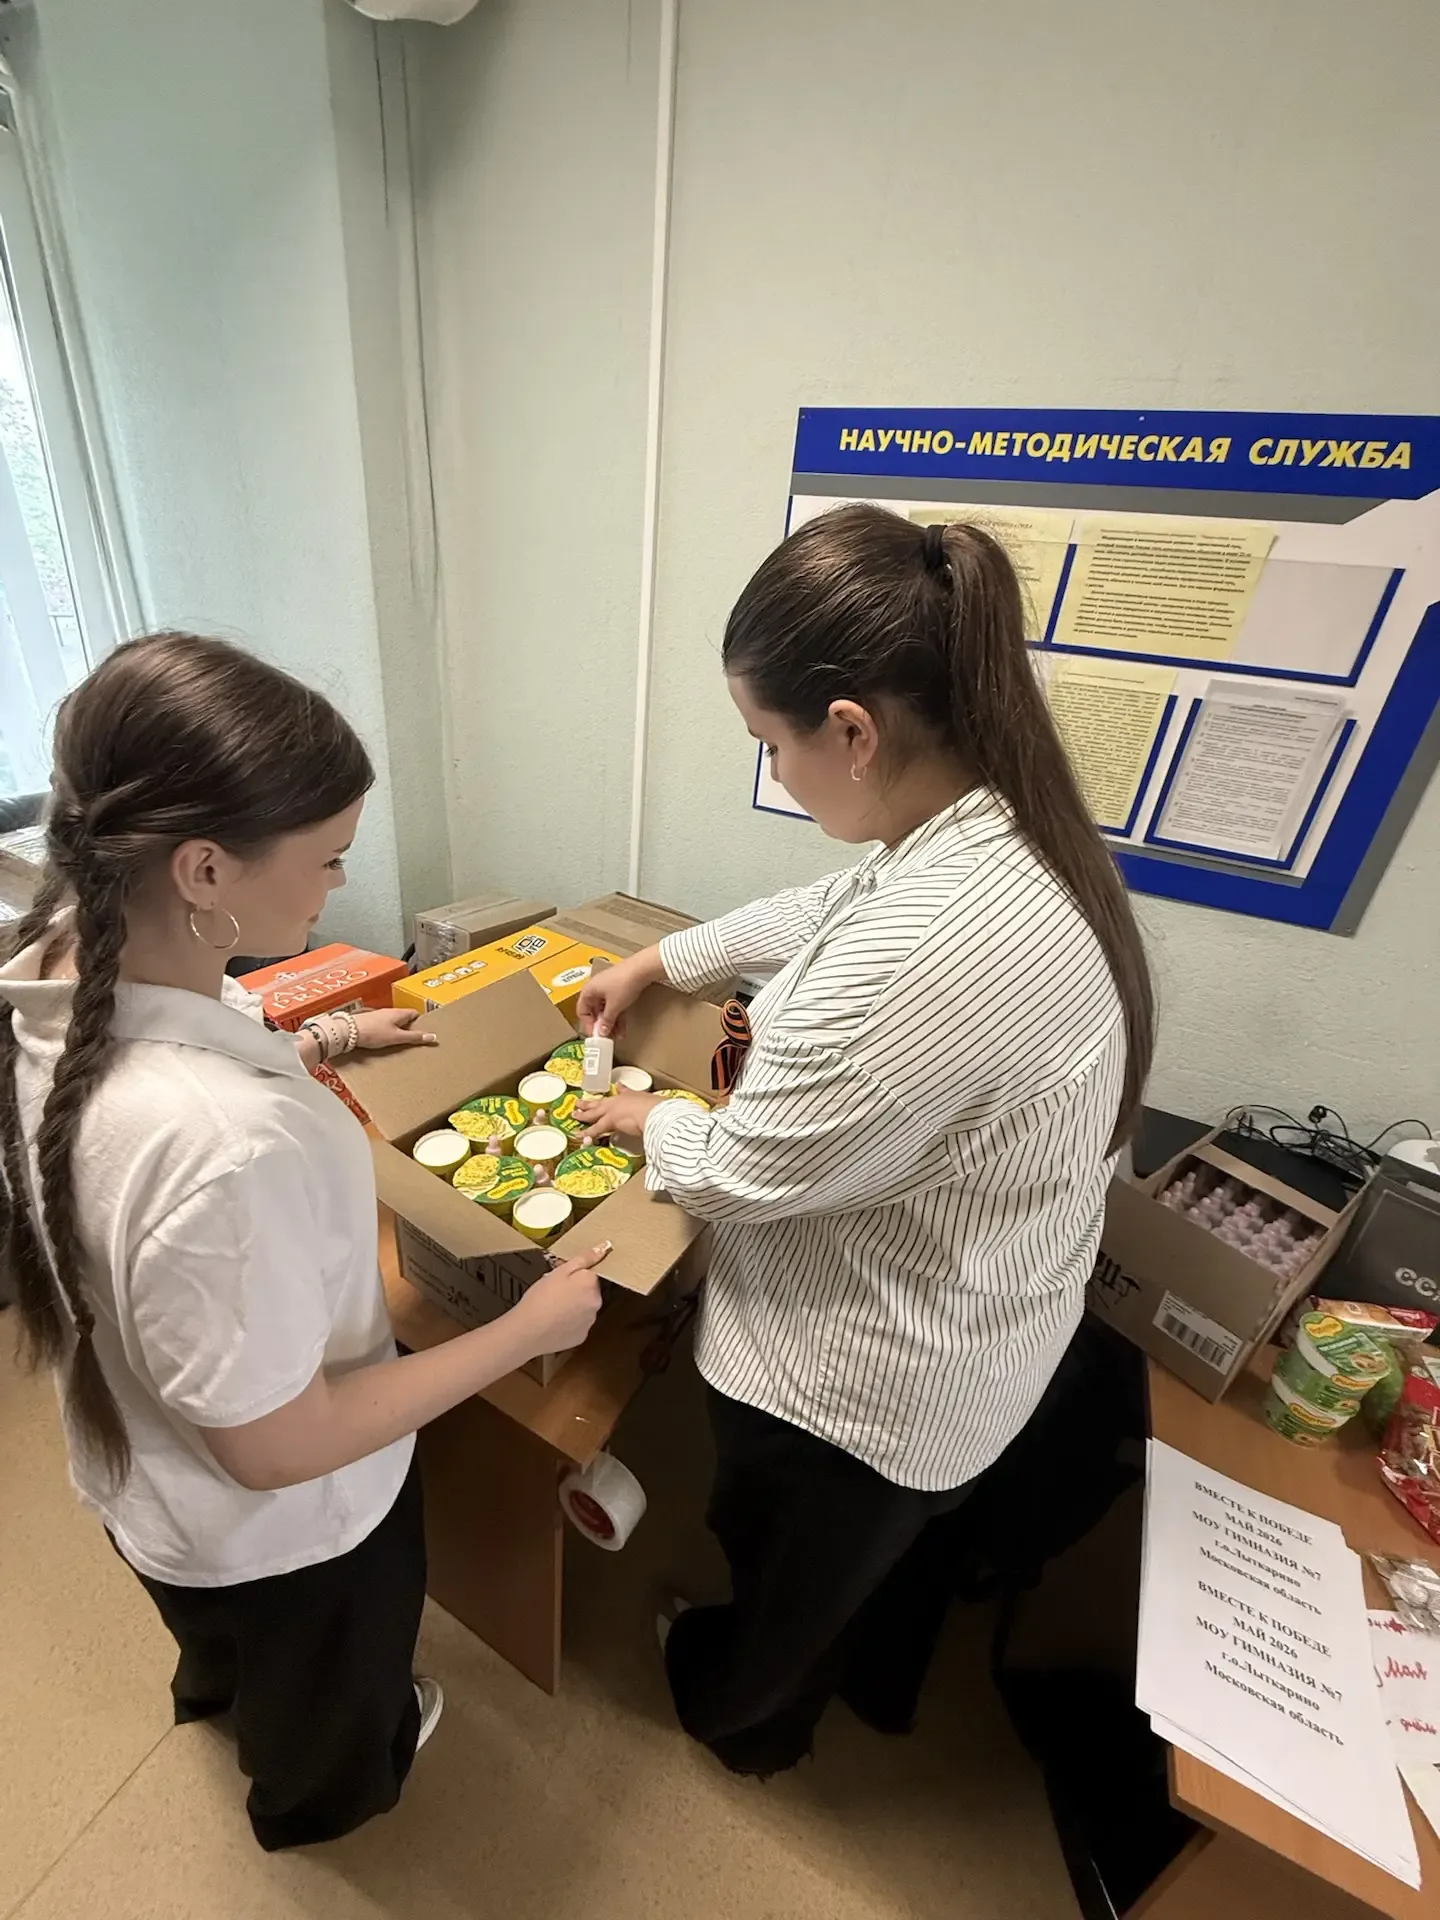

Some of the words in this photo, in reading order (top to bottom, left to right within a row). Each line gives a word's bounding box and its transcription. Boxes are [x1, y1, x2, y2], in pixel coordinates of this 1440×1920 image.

[839, 428, 1231, 464] НАУЧНО-МЕТОДИЧЕСКАЯ
[1247, 437, 1412, 470] СЛУЖБА
[272, 971, 368, 1008] PRIMO
[1192, 1510, 1221, 1529] МОУ
[1225, 1526, 1299, 1571] ГИМНАЗИЯ
[1194, 1481, 1245, 1513] ВМЕСТЕ
[1247, 1509, 1257, 1519] К
[1259, 1514, 1313, 1546] ПОБЕДЕ
[1225, 1511, 1253, 1533] МАЙ
[1256, 1528, 1283, 1546] 2026
[1199, 1546, 1270, 1589] Московская
[1273, 1586, 1322, 1615] область
[1198, 1580, 1256, 1617] ВМЕСТЕ
[1259, 1611, 1270, 1625] К
[1272, 1618, 1332, 1658] ПОБЕДЕ
[1232, 1615, 1266, 1641] МАЙ
[1269, 1636, 1298, 1659] 2026
[1196, 1615, 1229, 1639] МОУ
[1233, 1635, 1316, 1689] ГИМНАЗИЯ
[1320, 1682, 1343, 1702] №7
[1205, 1659, 1286, 1714] Московская
[1289, 1709, 1344, 1746] область
